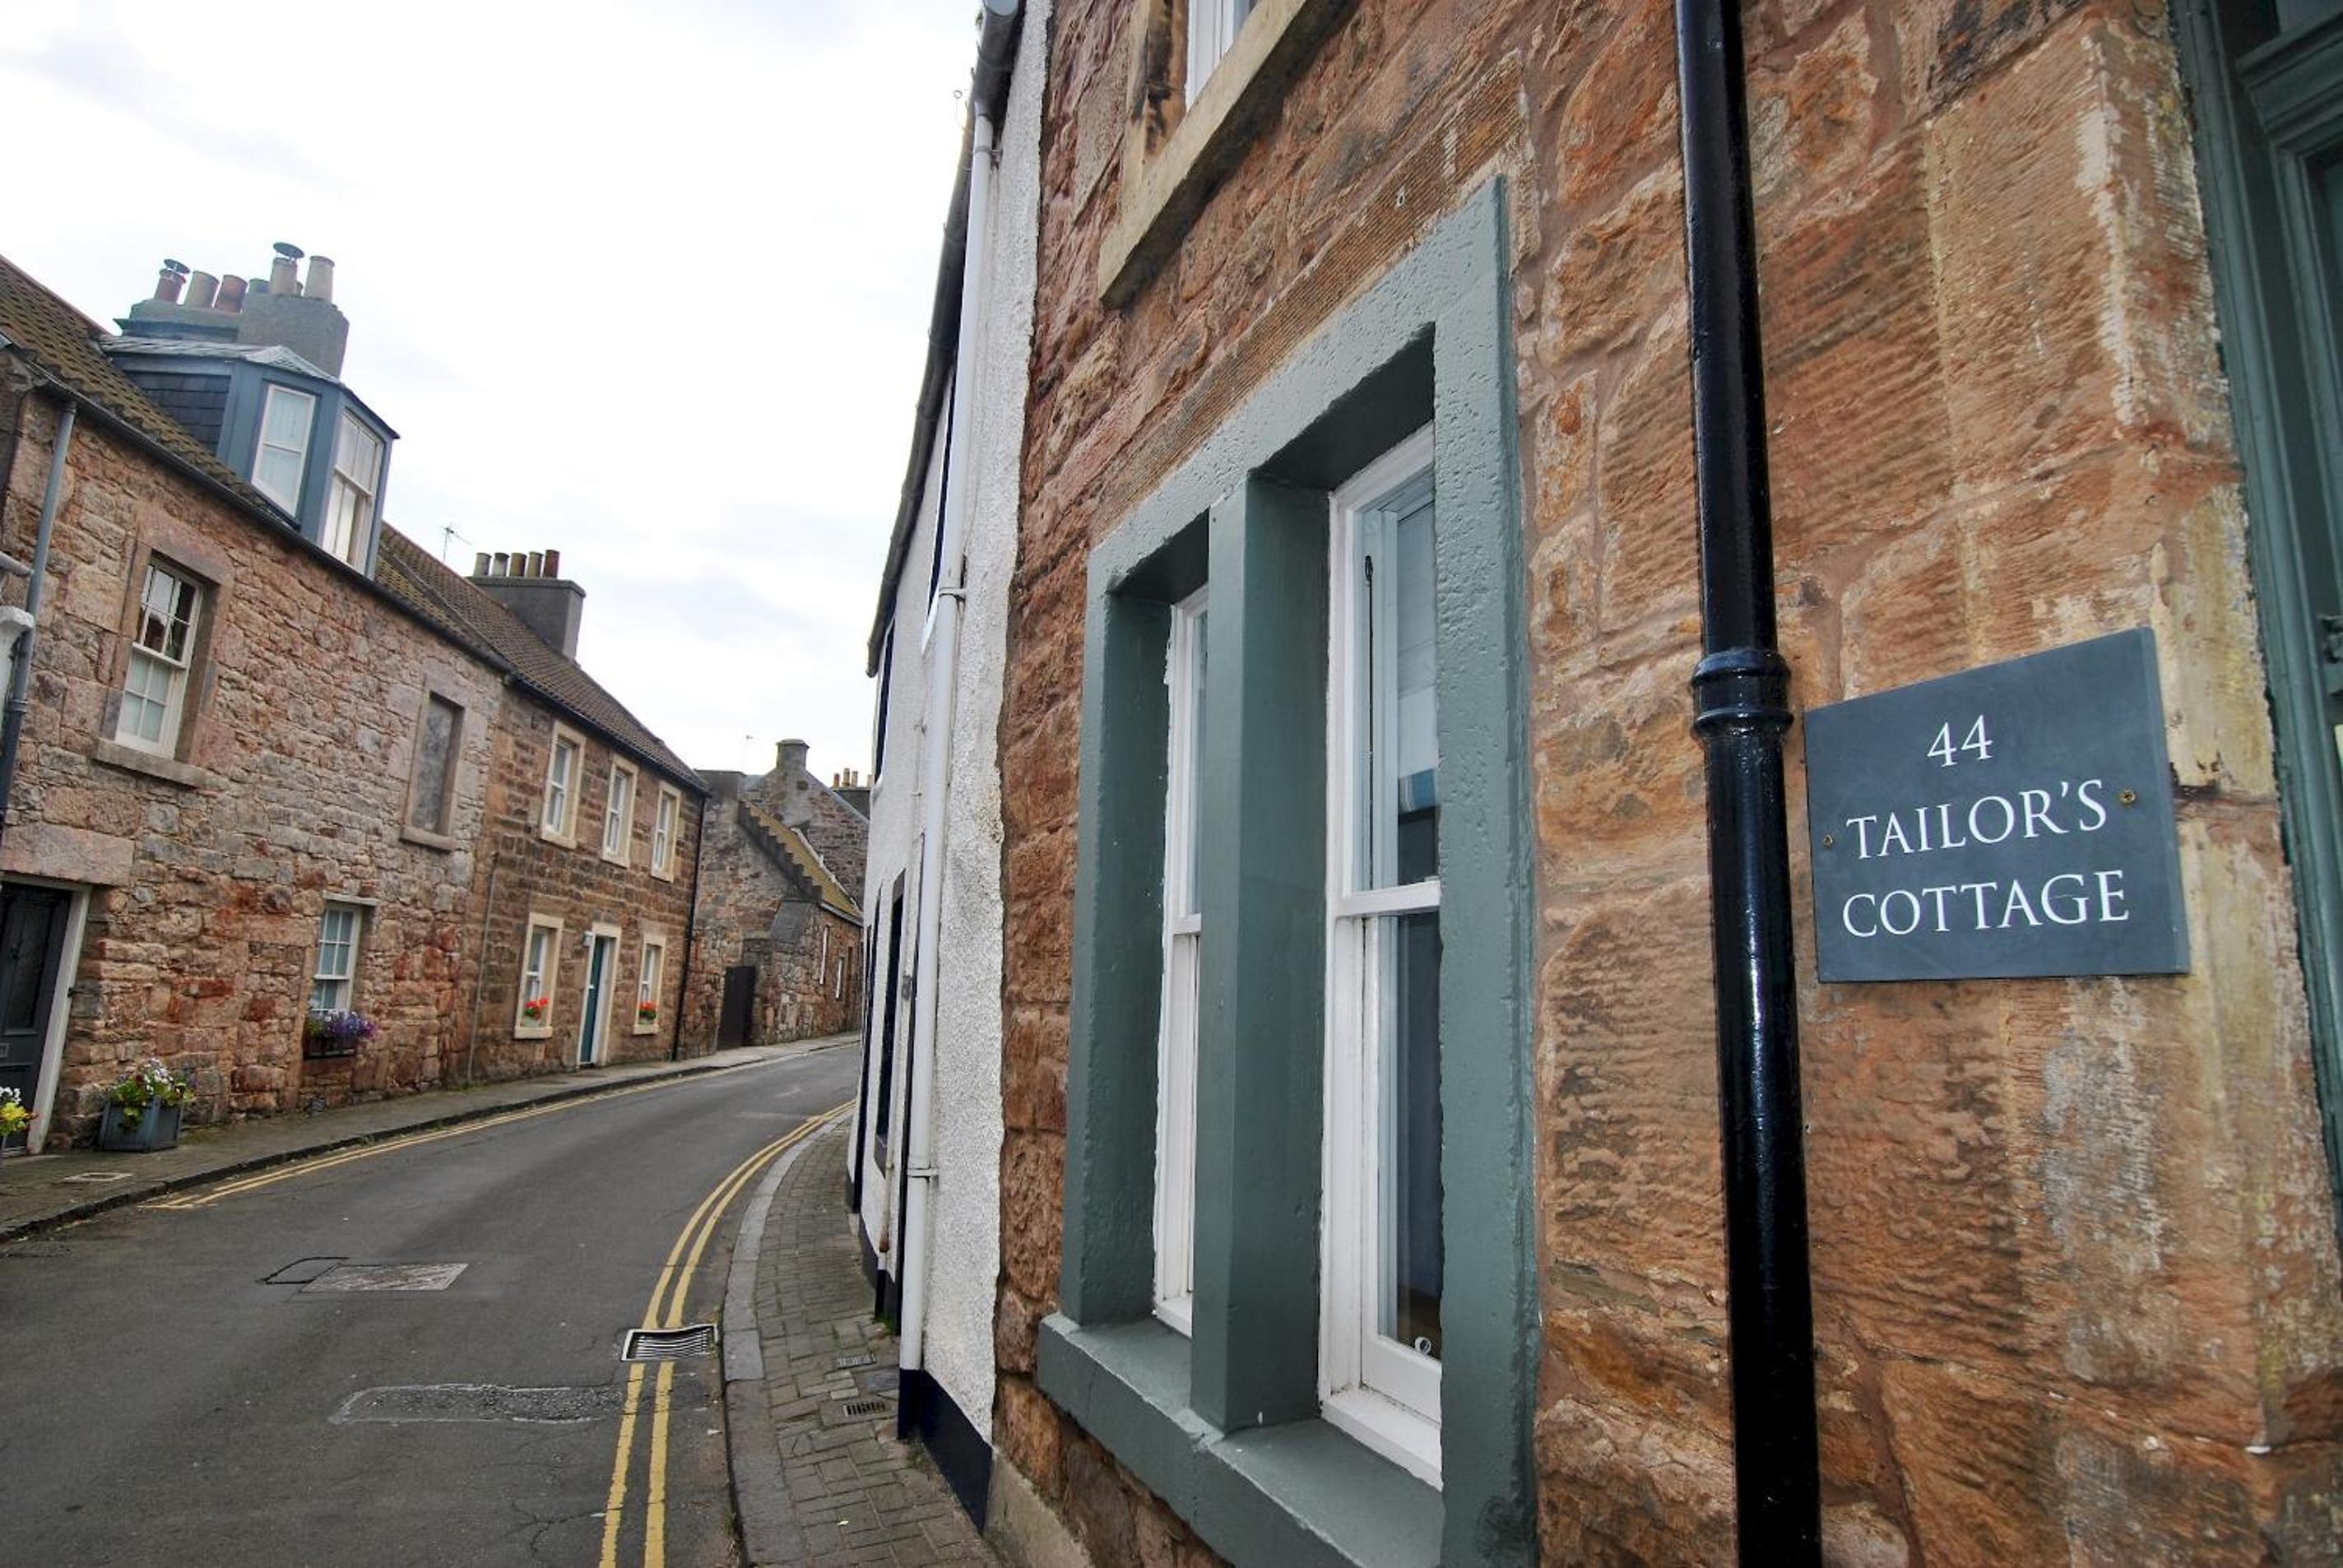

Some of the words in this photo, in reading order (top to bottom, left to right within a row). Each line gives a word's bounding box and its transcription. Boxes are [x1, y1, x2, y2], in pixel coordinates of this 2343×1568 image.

[1927, 714, 1993, 768] 44
[1845, 779, 2106, 859] TAILOR'S
[1842, 870, 2129, 937] COTTAGE
